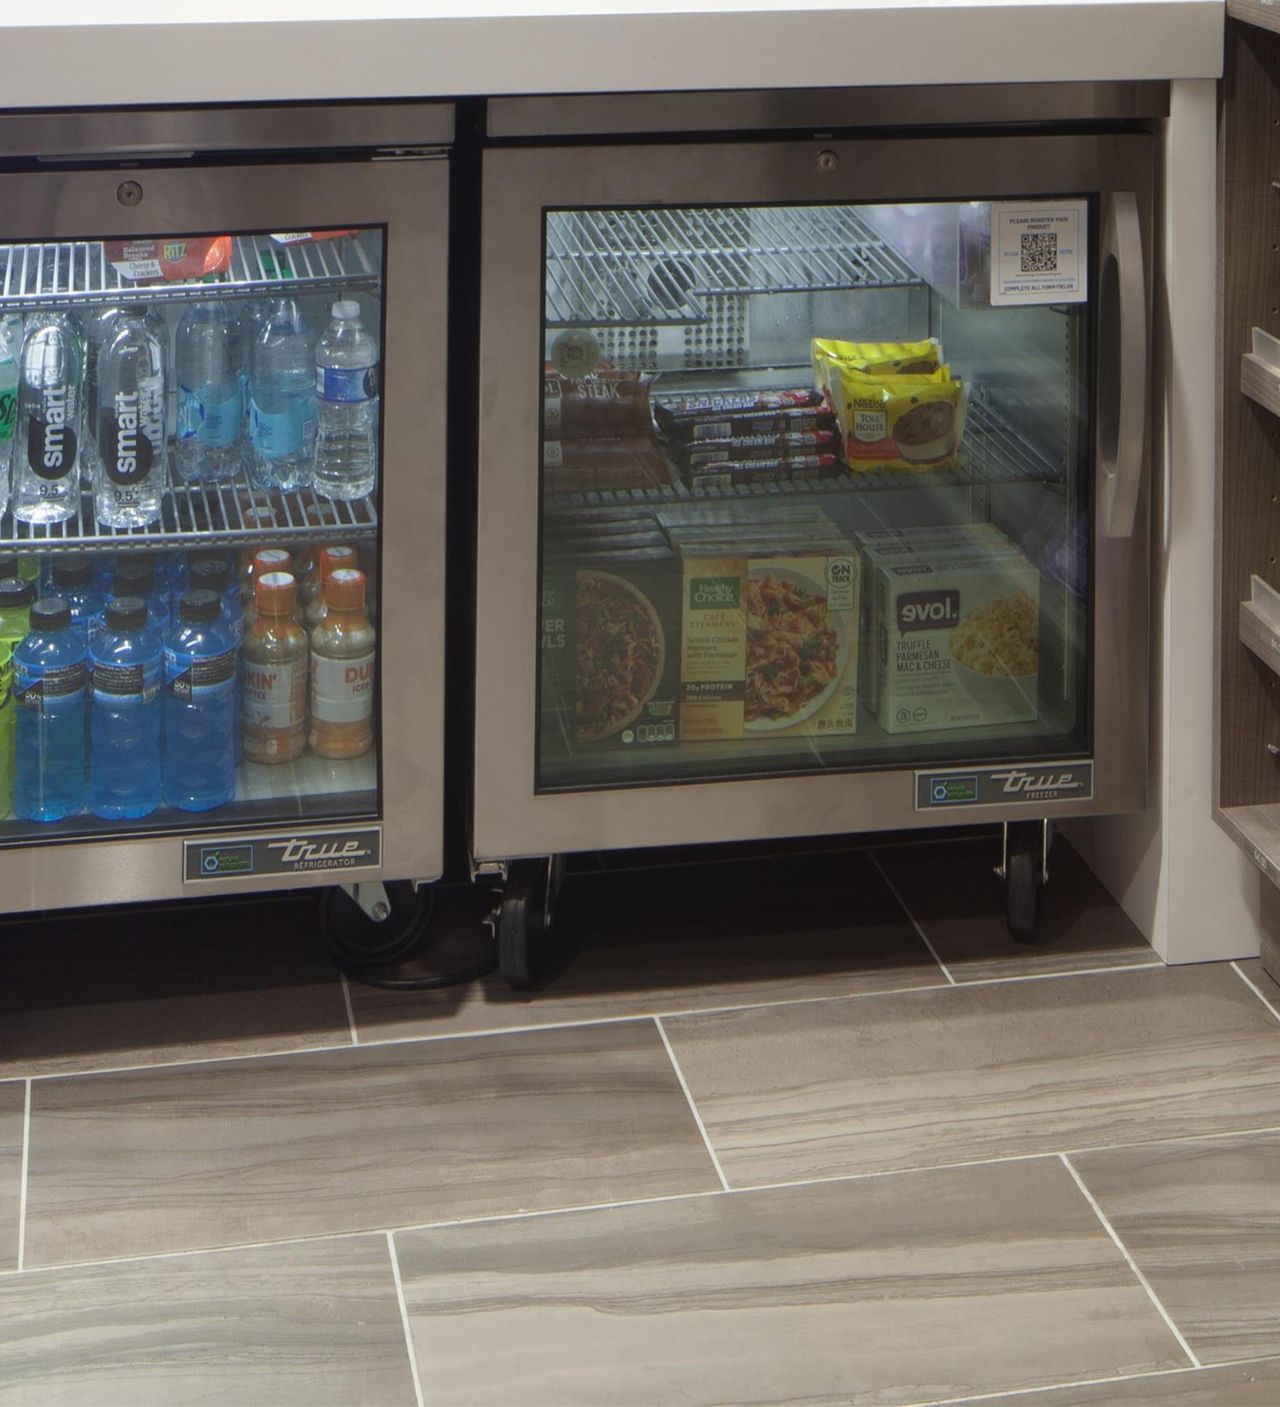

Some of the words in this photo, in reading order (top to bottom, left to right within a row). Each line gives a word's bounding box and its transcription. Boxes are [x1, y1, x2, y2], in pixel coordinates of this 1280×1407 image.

[163, 242, 187, 259] RITZ
[577, 383, 620, 400] STEAK
[860, 413, 881, 424] TOLL
[43, 385, 68, 468] smart
[116, 391, 140, 474] smart
[855, 422, 884, 433] HOUSE
[694, 591, 735, 603] Choice
[896, 639, 931, 651] TRUFFLE
[896, 649, 940, 661] PARMESAN
[896, 661, 915, 672] MAC
[922, 659, 952, 671] CHEESE
[1026, 790, 1059, 801] FREEZER
[294, 857, 356, 871] REFRIGERATOR
